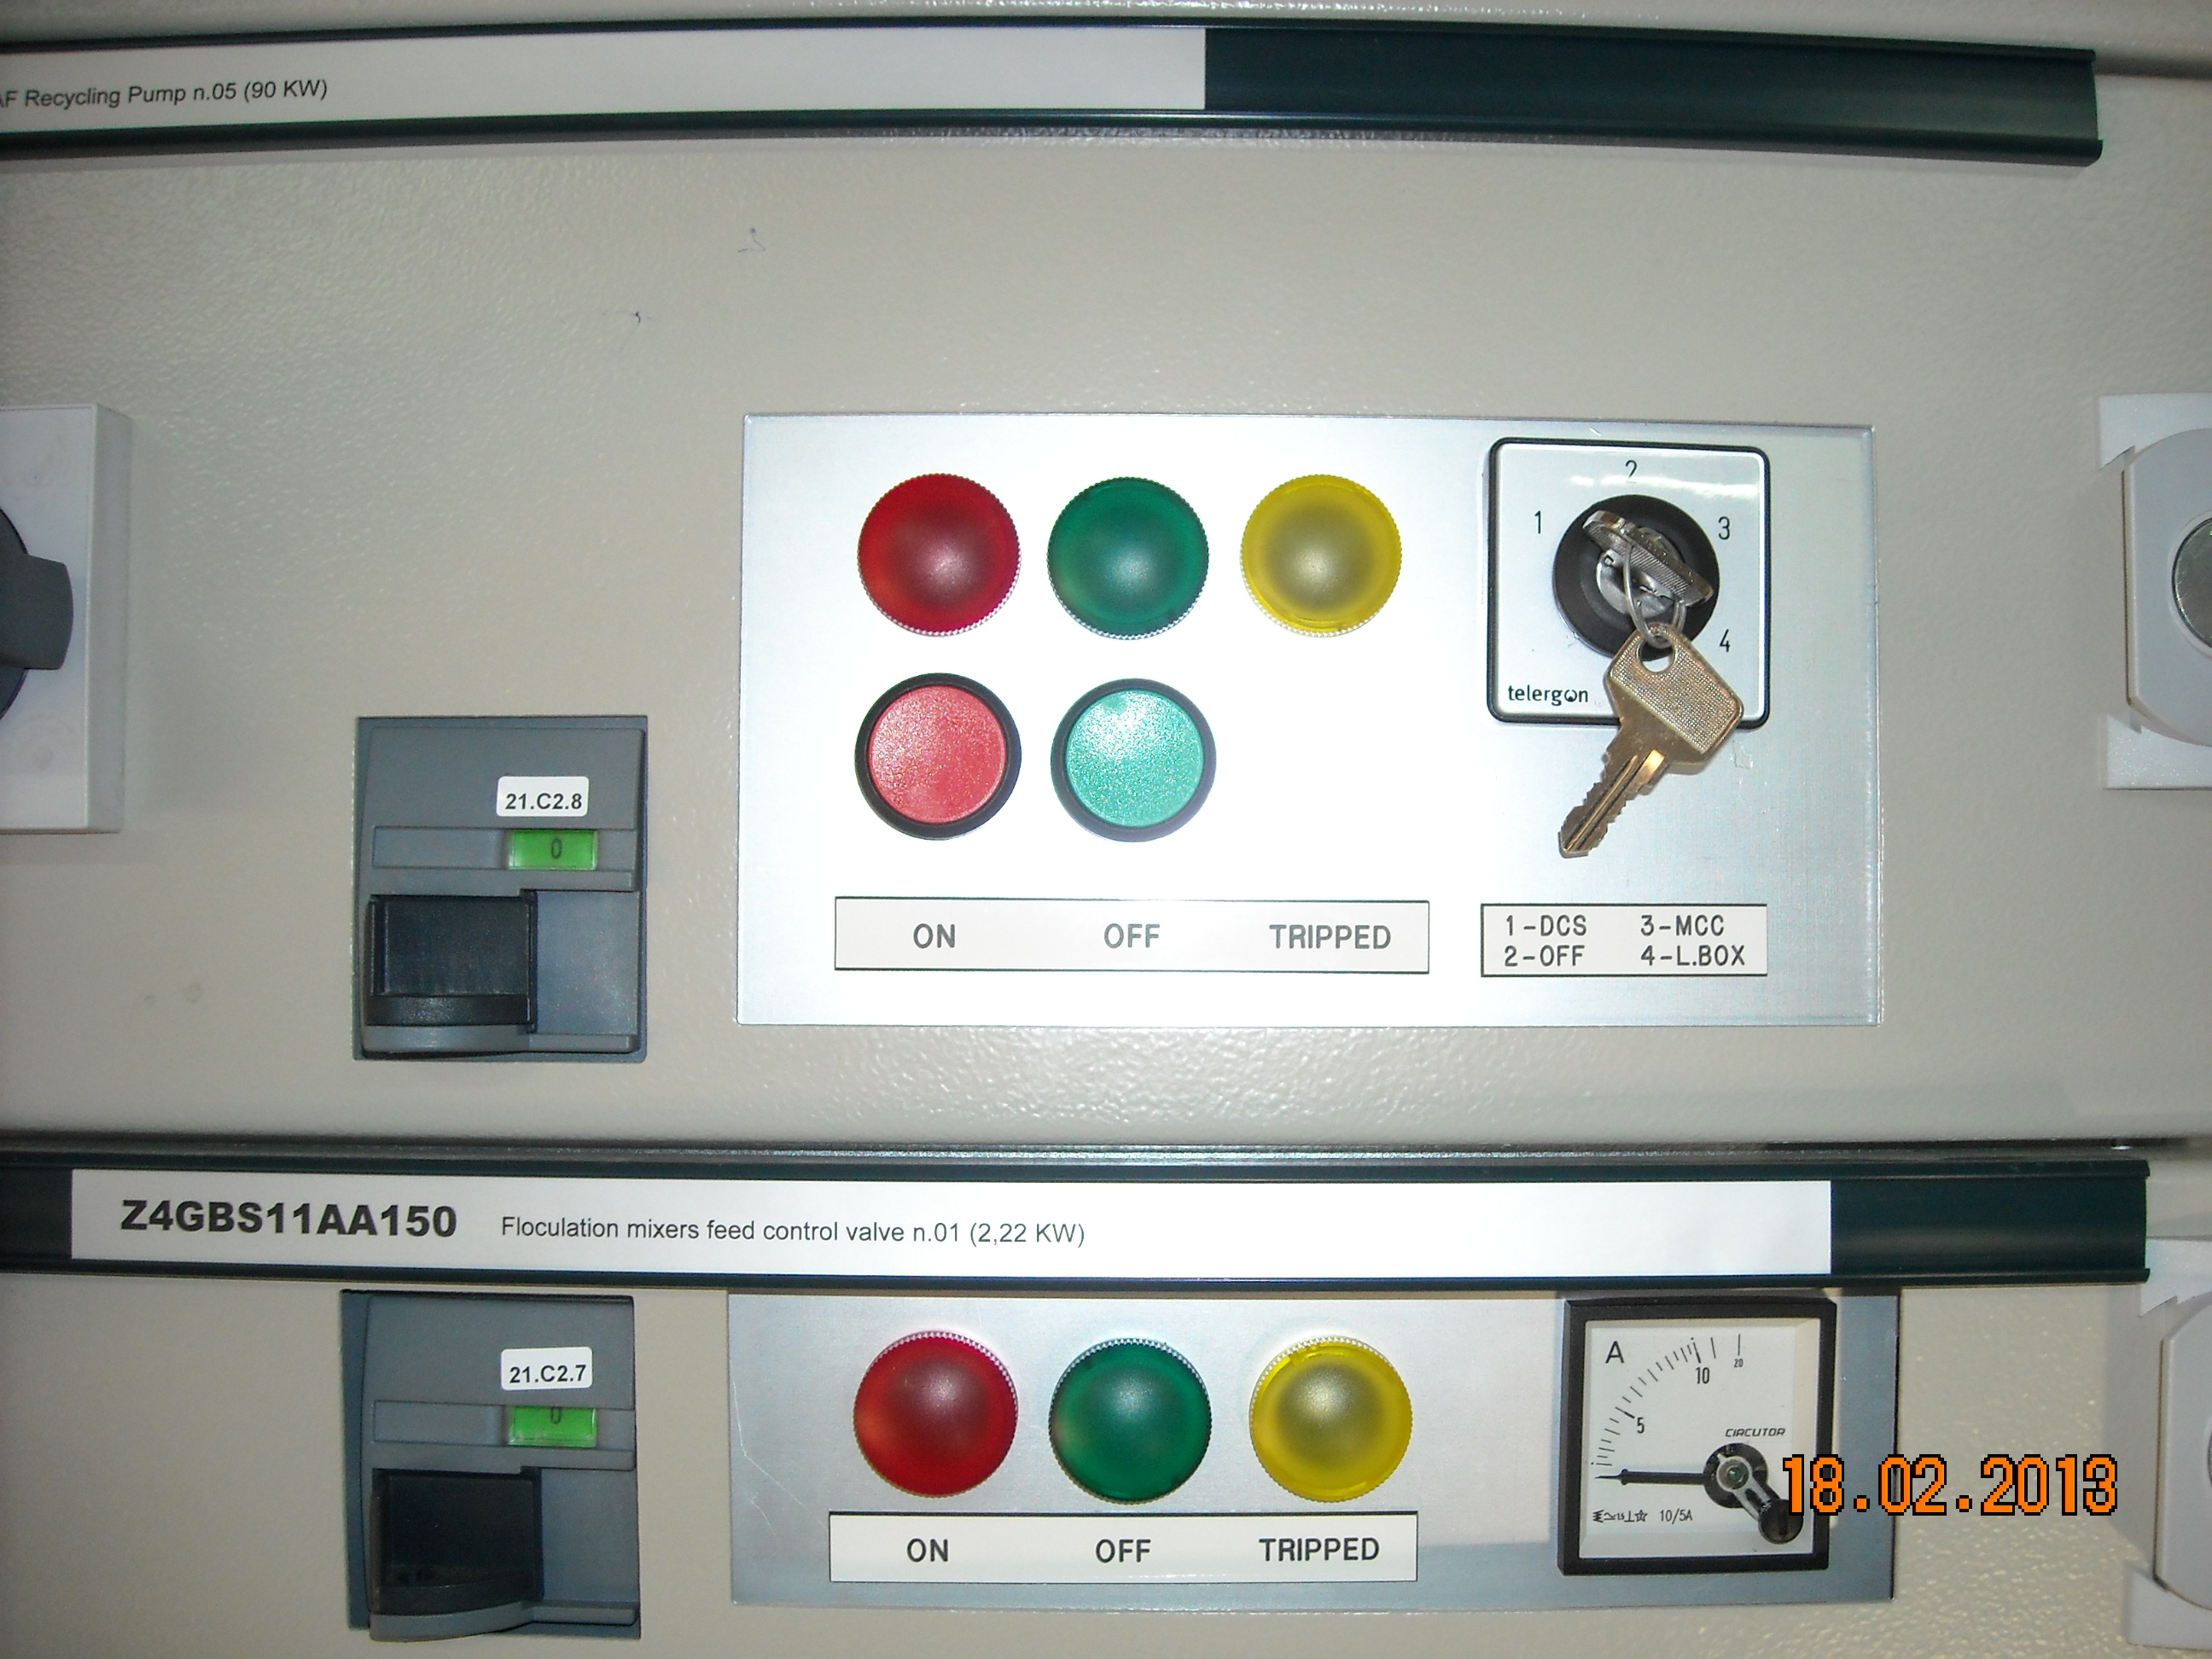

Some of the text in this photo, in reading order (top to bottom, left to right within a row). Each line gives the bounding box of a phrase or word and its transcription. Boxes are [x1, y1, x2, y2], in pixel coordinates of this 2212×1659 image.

[0, 79, 328, 110] F Recycling Pump n.05 (90 KW)
[1625, 460, 1638, 484] 2
[1534, 510, 1542, 534] 1
[1718, 516, 1731, 540] 3
[1720, 629, 1731, 653] 4
[1507, 684, 1589, 707] telergon
[504, 792, 582, 810] 21.C2.8
[913, 923, 1392, 951] ON OFF TRIPPED
[1640, 915, 1725, 936] 3-MCC
[1640, 945, 1746, 966] 4-L.BOX
[120, 1199, 1085, 1248] Z4GBS11AA150 Floculation mixers feed control valve n.01 (2,22 KW)
[1605, 1341, 1624, 1364] A
[1733, 1358, 1743, 1369] 20
[509, 1365, 586, 1384] 21.C2.7
[1696, 1367, 1710, 1384] 10
[1637, 1417, 1645, 1435] 5
[1725, 1428, 1786, 1437] CIRCUTOR
[1660, 1508, 1693, 1524] 10/5A
[906, 1538, 1380, 1563] ON OFF TRIPPED
